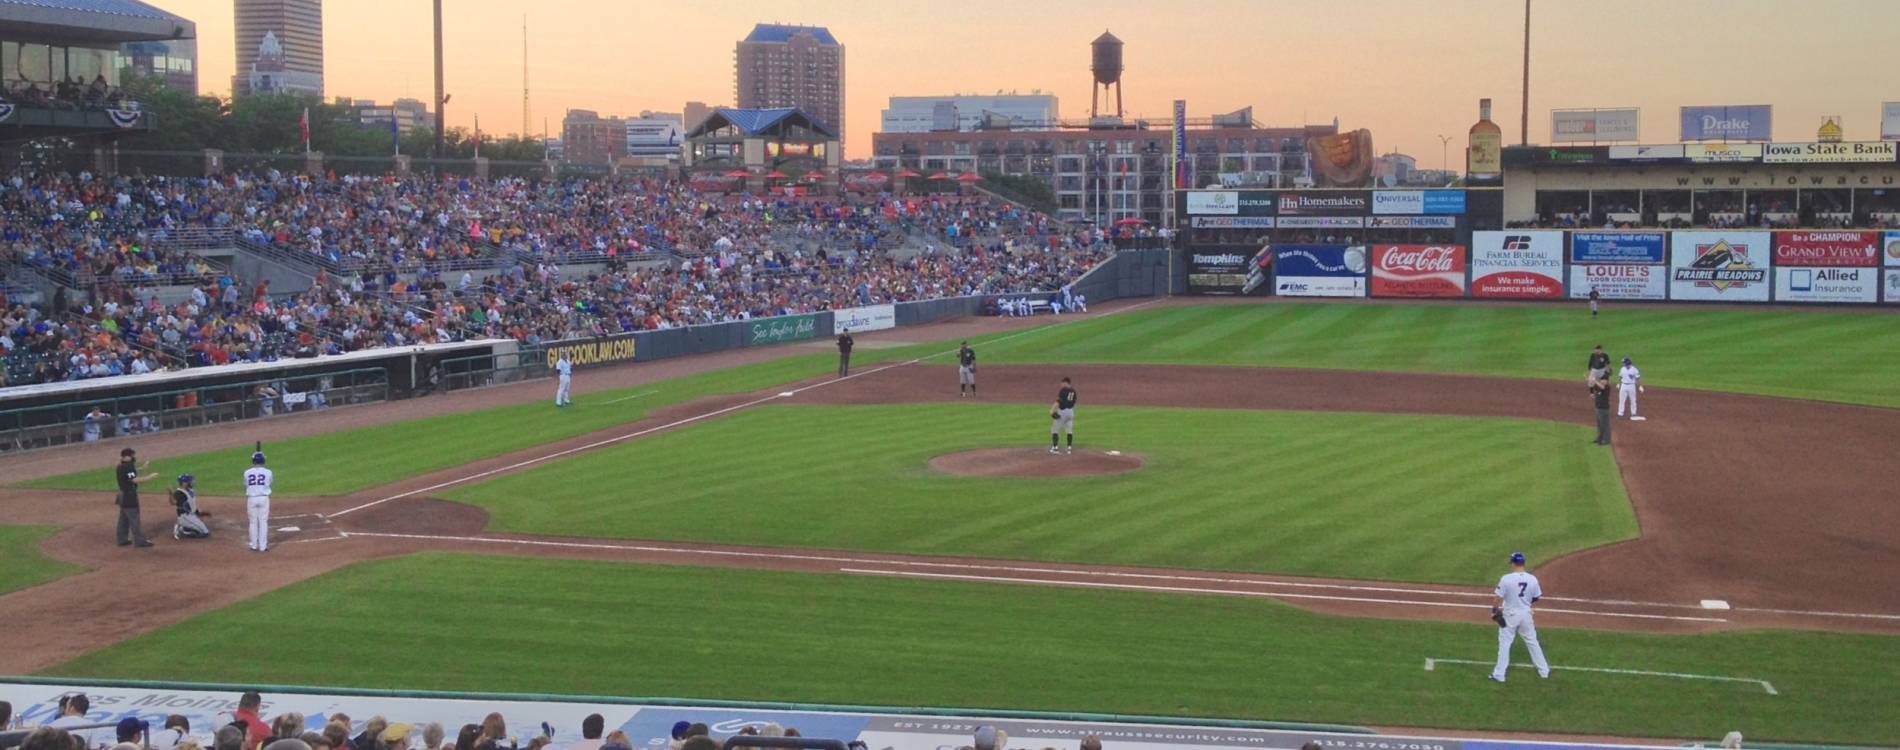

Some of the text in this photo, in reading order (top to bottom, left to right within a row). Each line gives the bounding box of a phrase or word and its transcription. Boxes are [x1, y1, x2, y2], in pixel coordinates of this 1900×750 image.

[1702, 115, 1750, 130] Drake
[1766, 143, 1894, 156] Iowa State Bank
[1299, 196, 1365, 207] Homemakers
[1810, 233, 1861, 242] CHAMPION!
[1487, 251, 1548, 259] FARM BUREAU
[1778, 245, 1863, 257] GRAND VIEW
[1193, 254, 1245, 265] Tompkins
[1381, 246, 1456, 271] Coca-Cola
[1475, 259, 1561, 267] FINANCIAL SERVICES
[1586, 265, 1650, 277] LOUIE'S
[1677, 271, 1763, 282] PRAIRIE MEADOWS
[1816, 269, 1859, 281] Allied
[1513, 277, 1535, 285] make
[1523, 286, 1551, 294] simple.
[1815, 284, 1863, 293] Insurance
[248, 474, 266, 486] 22
[1518, 582, 1528, 597] 7
[894, 722, 974, 734] EST 1927
